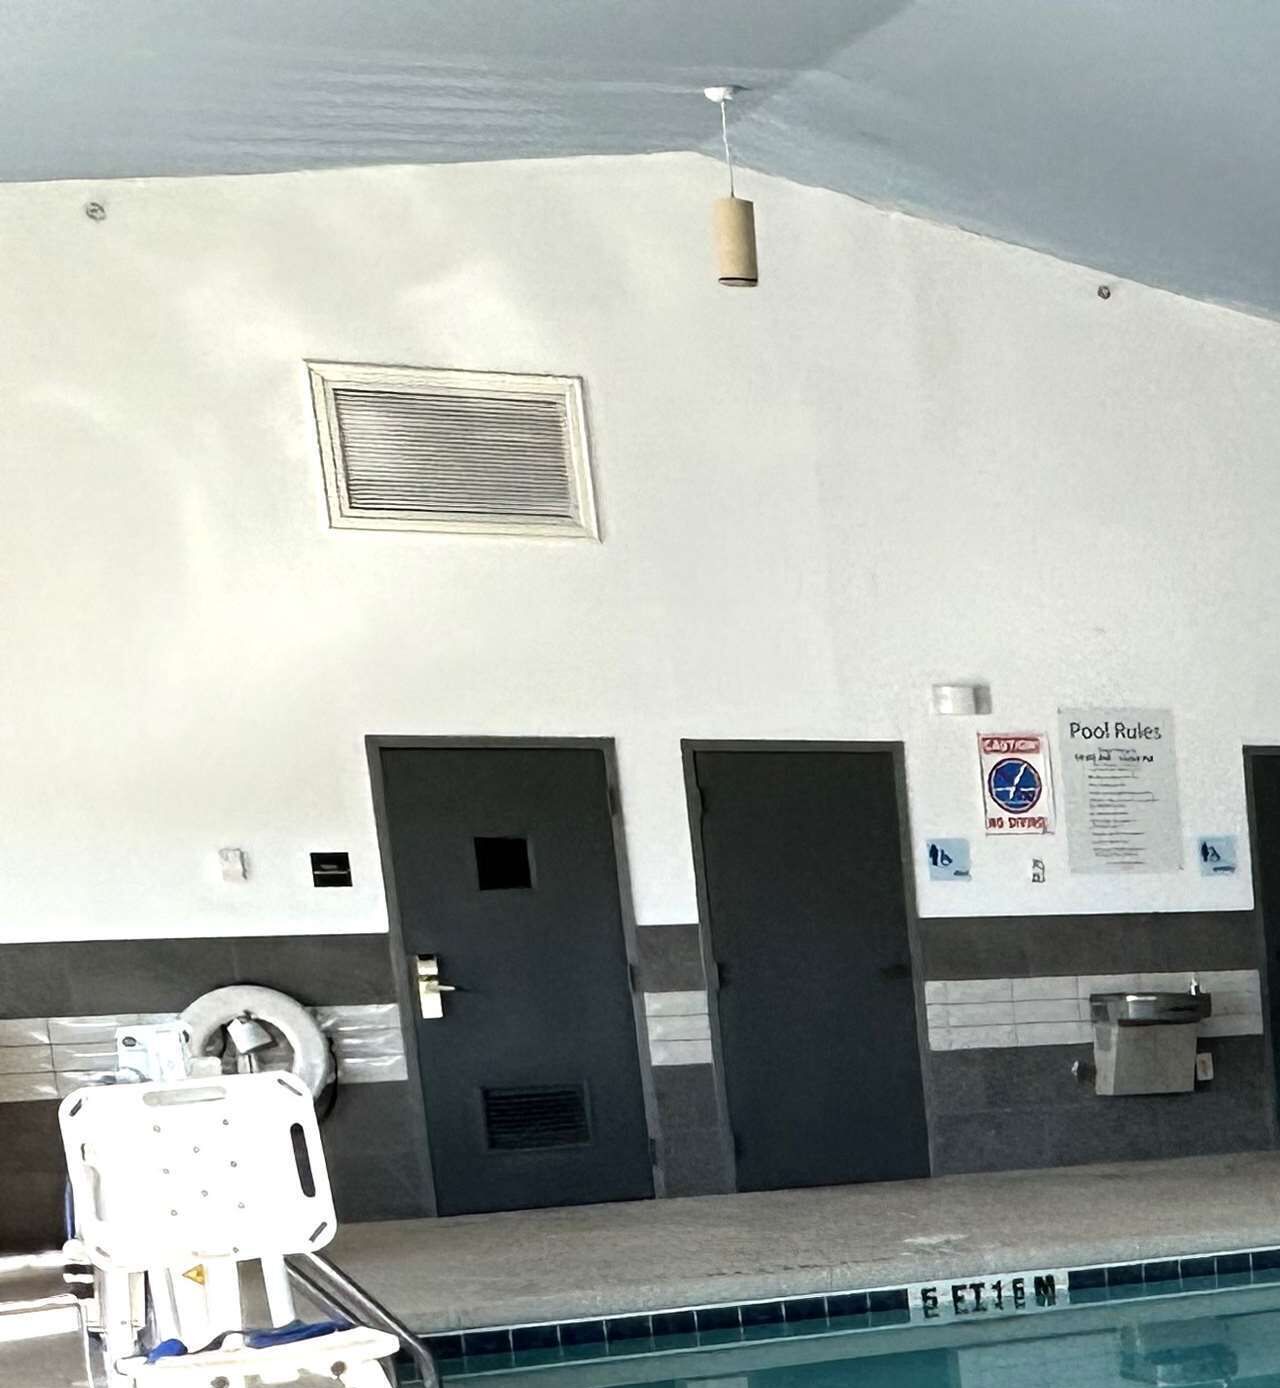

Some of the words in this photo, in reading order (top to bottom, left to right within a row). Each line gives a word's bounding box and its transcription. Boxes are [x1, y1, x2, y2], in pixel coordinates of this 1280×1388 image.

[1070, 722, 1109, 739] Pool
[1115, 722, 1162, 740] Rules
[988, 817, 1003, 828] NO
